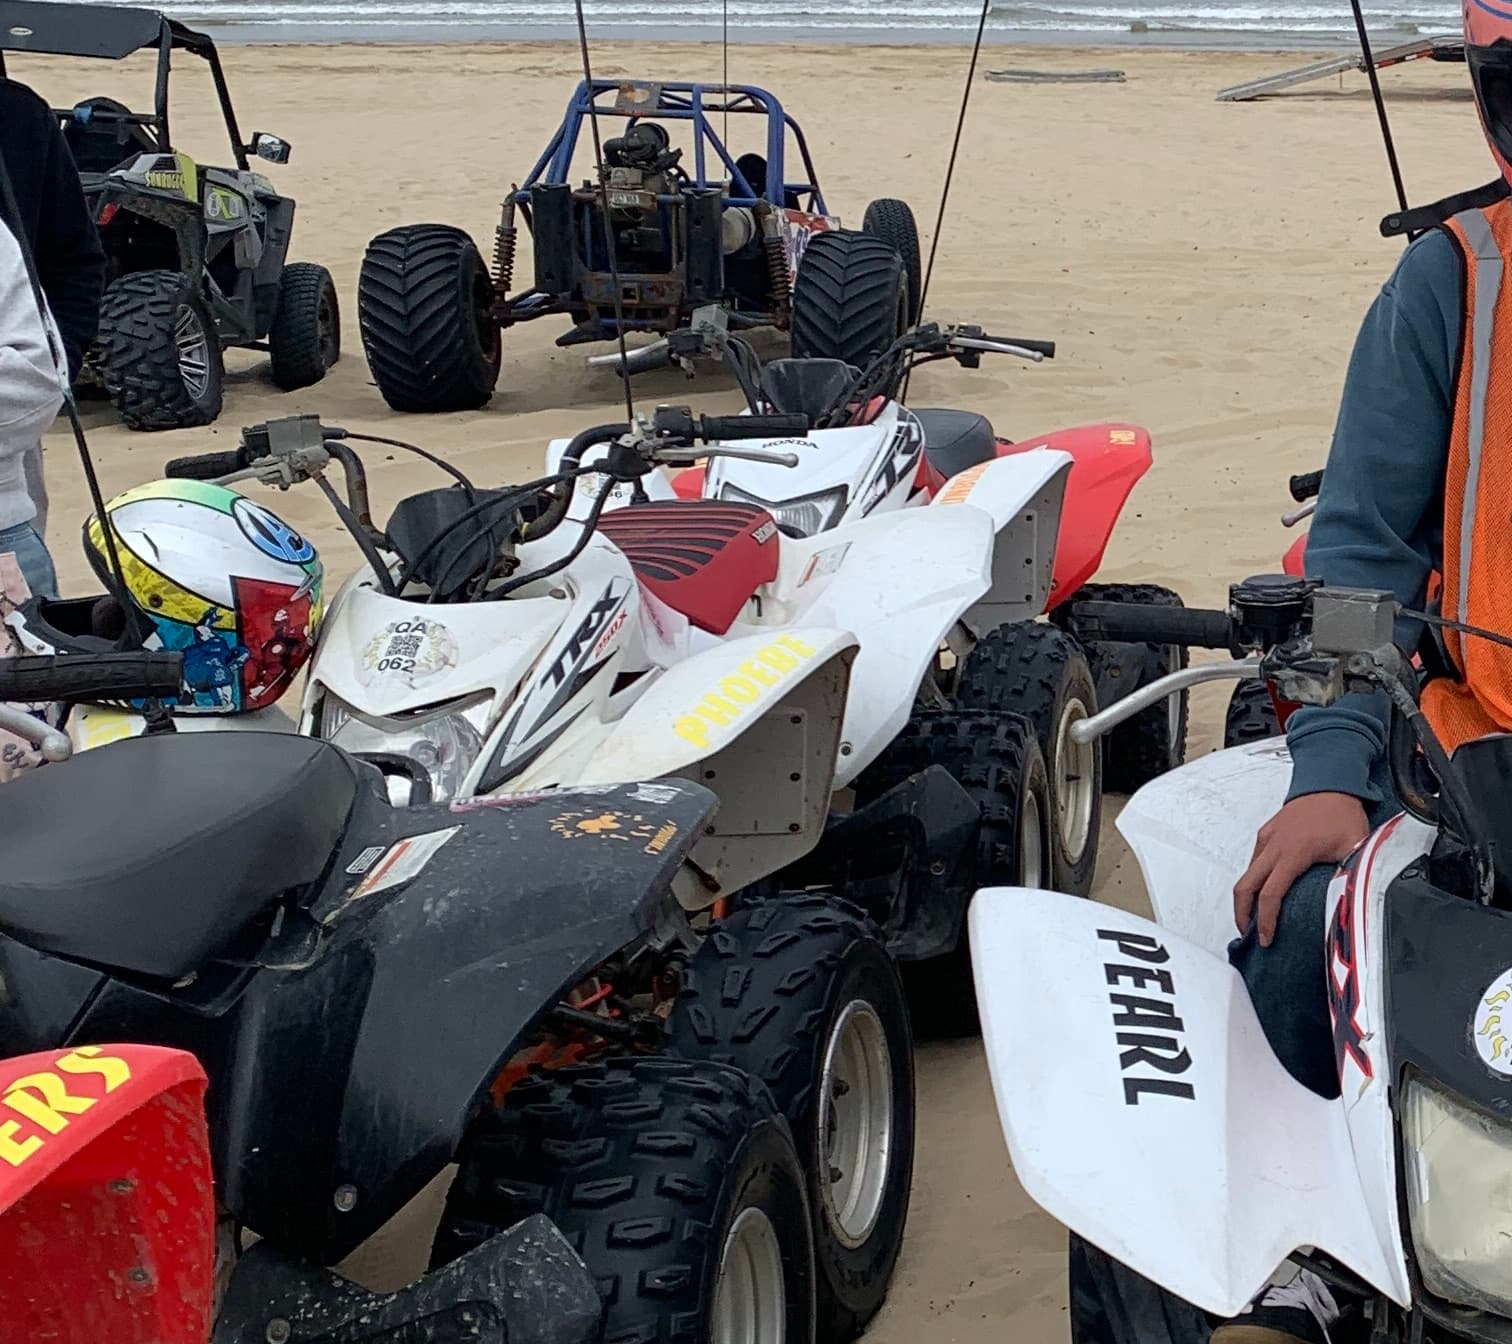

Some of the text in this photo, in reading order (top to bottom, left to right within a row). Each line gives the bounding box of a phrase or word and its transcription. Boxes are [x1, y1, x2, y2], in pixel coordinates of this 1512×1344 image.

[762, 439, 819, 449] HONDA
[395, 622, 427, 635] QA
[540, 576, 621, 690] TRX
[378, 658, 417, 673] 062
[675, 634, 816, 748] PHOEBE
[1096, 929, 1196, 1105] PEARL
